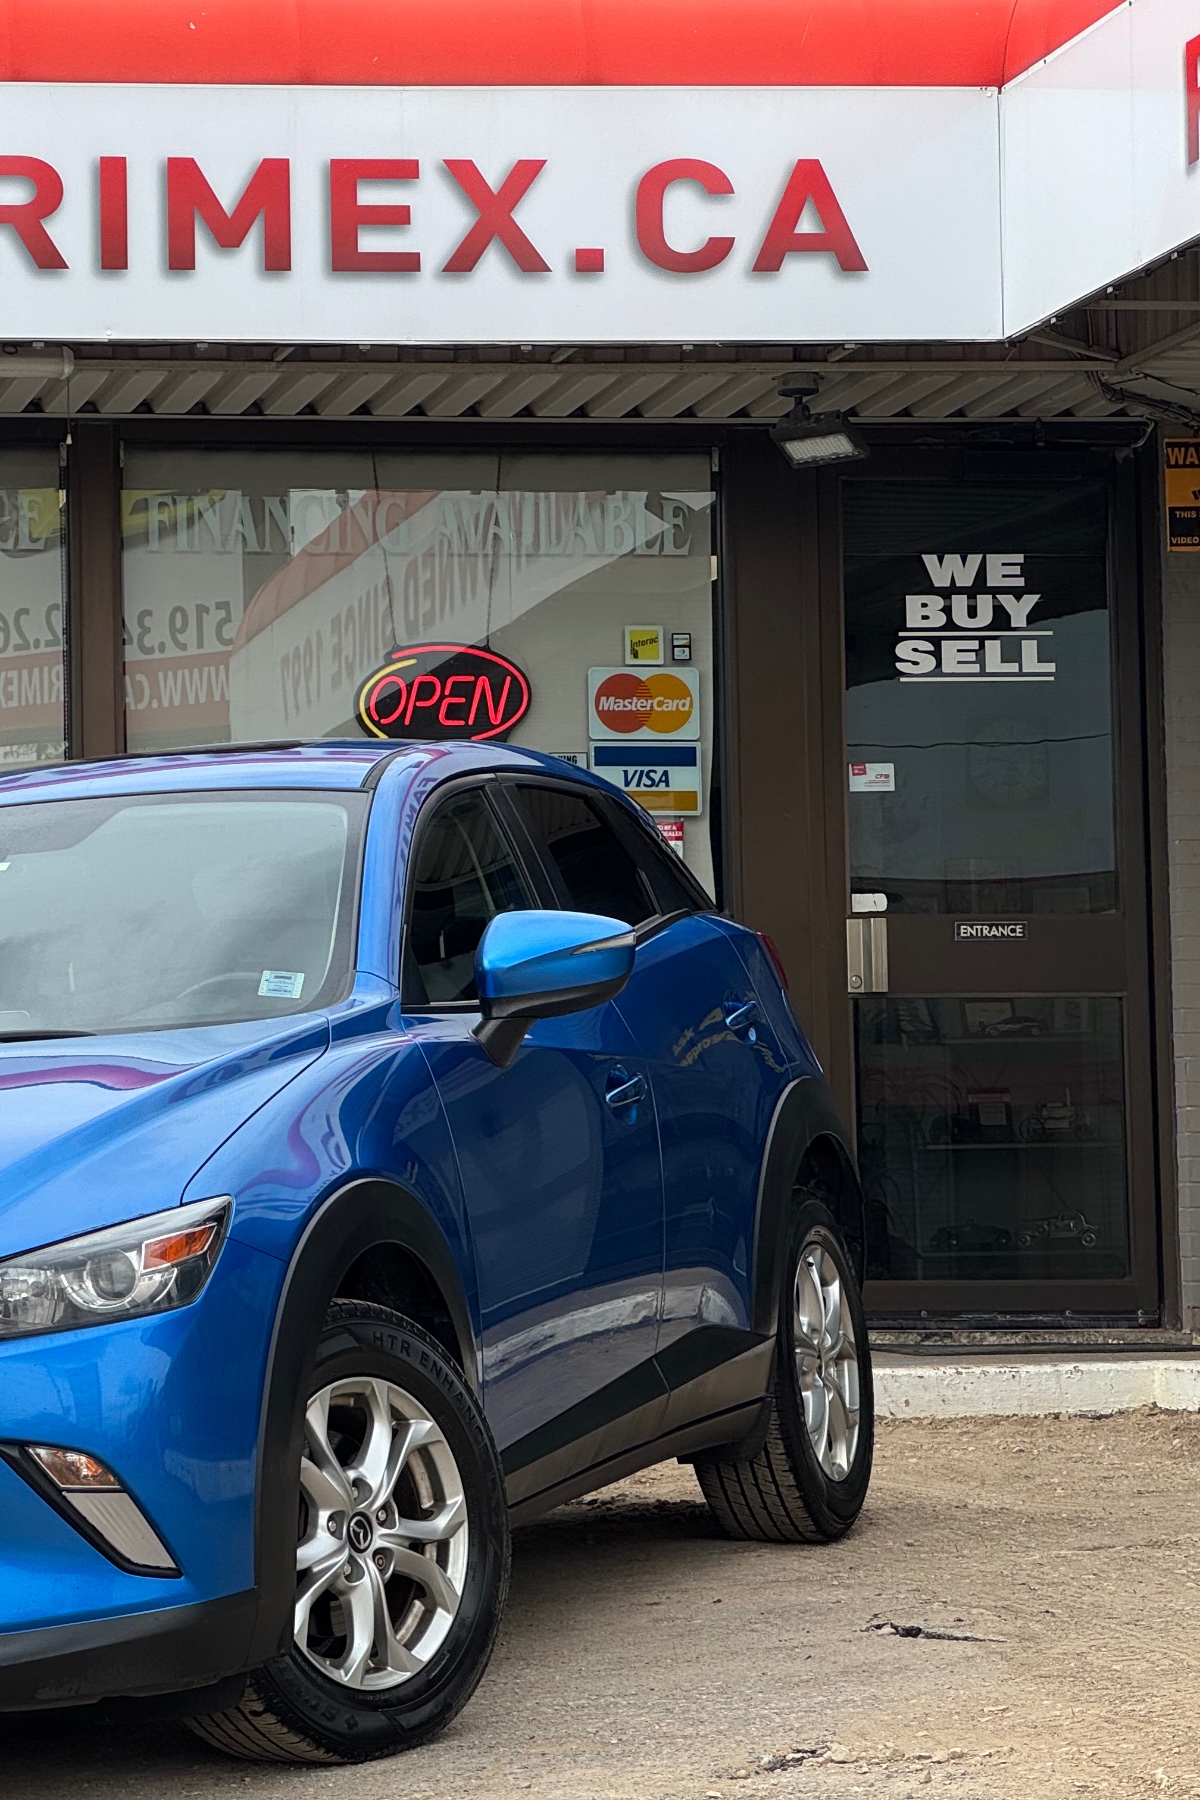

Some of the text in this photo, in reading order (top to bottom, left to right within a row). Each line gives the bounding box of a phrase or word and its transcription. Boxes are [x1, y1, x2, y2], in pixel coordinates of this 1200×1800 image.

[1167, 447, 1200, 466] WA
[1175, 510, 1197, 518] THIS
[1171, 536, 1200, 544] VIDEO
[921, 553, 1025, 587] WE
[905, 594, 1042, 628] BUY
[630, 636, 659, 649] Interac
[895, 639, 1056, 674] SELL
[368, 675, 513, 726] OPEN
[598, 696, 691, 712] MasterCard
[621, 769, 670, 788] VISA
[960, 925, 1023, 937] ENTRANCE
[373, 1331, 411, 1358] HTR
